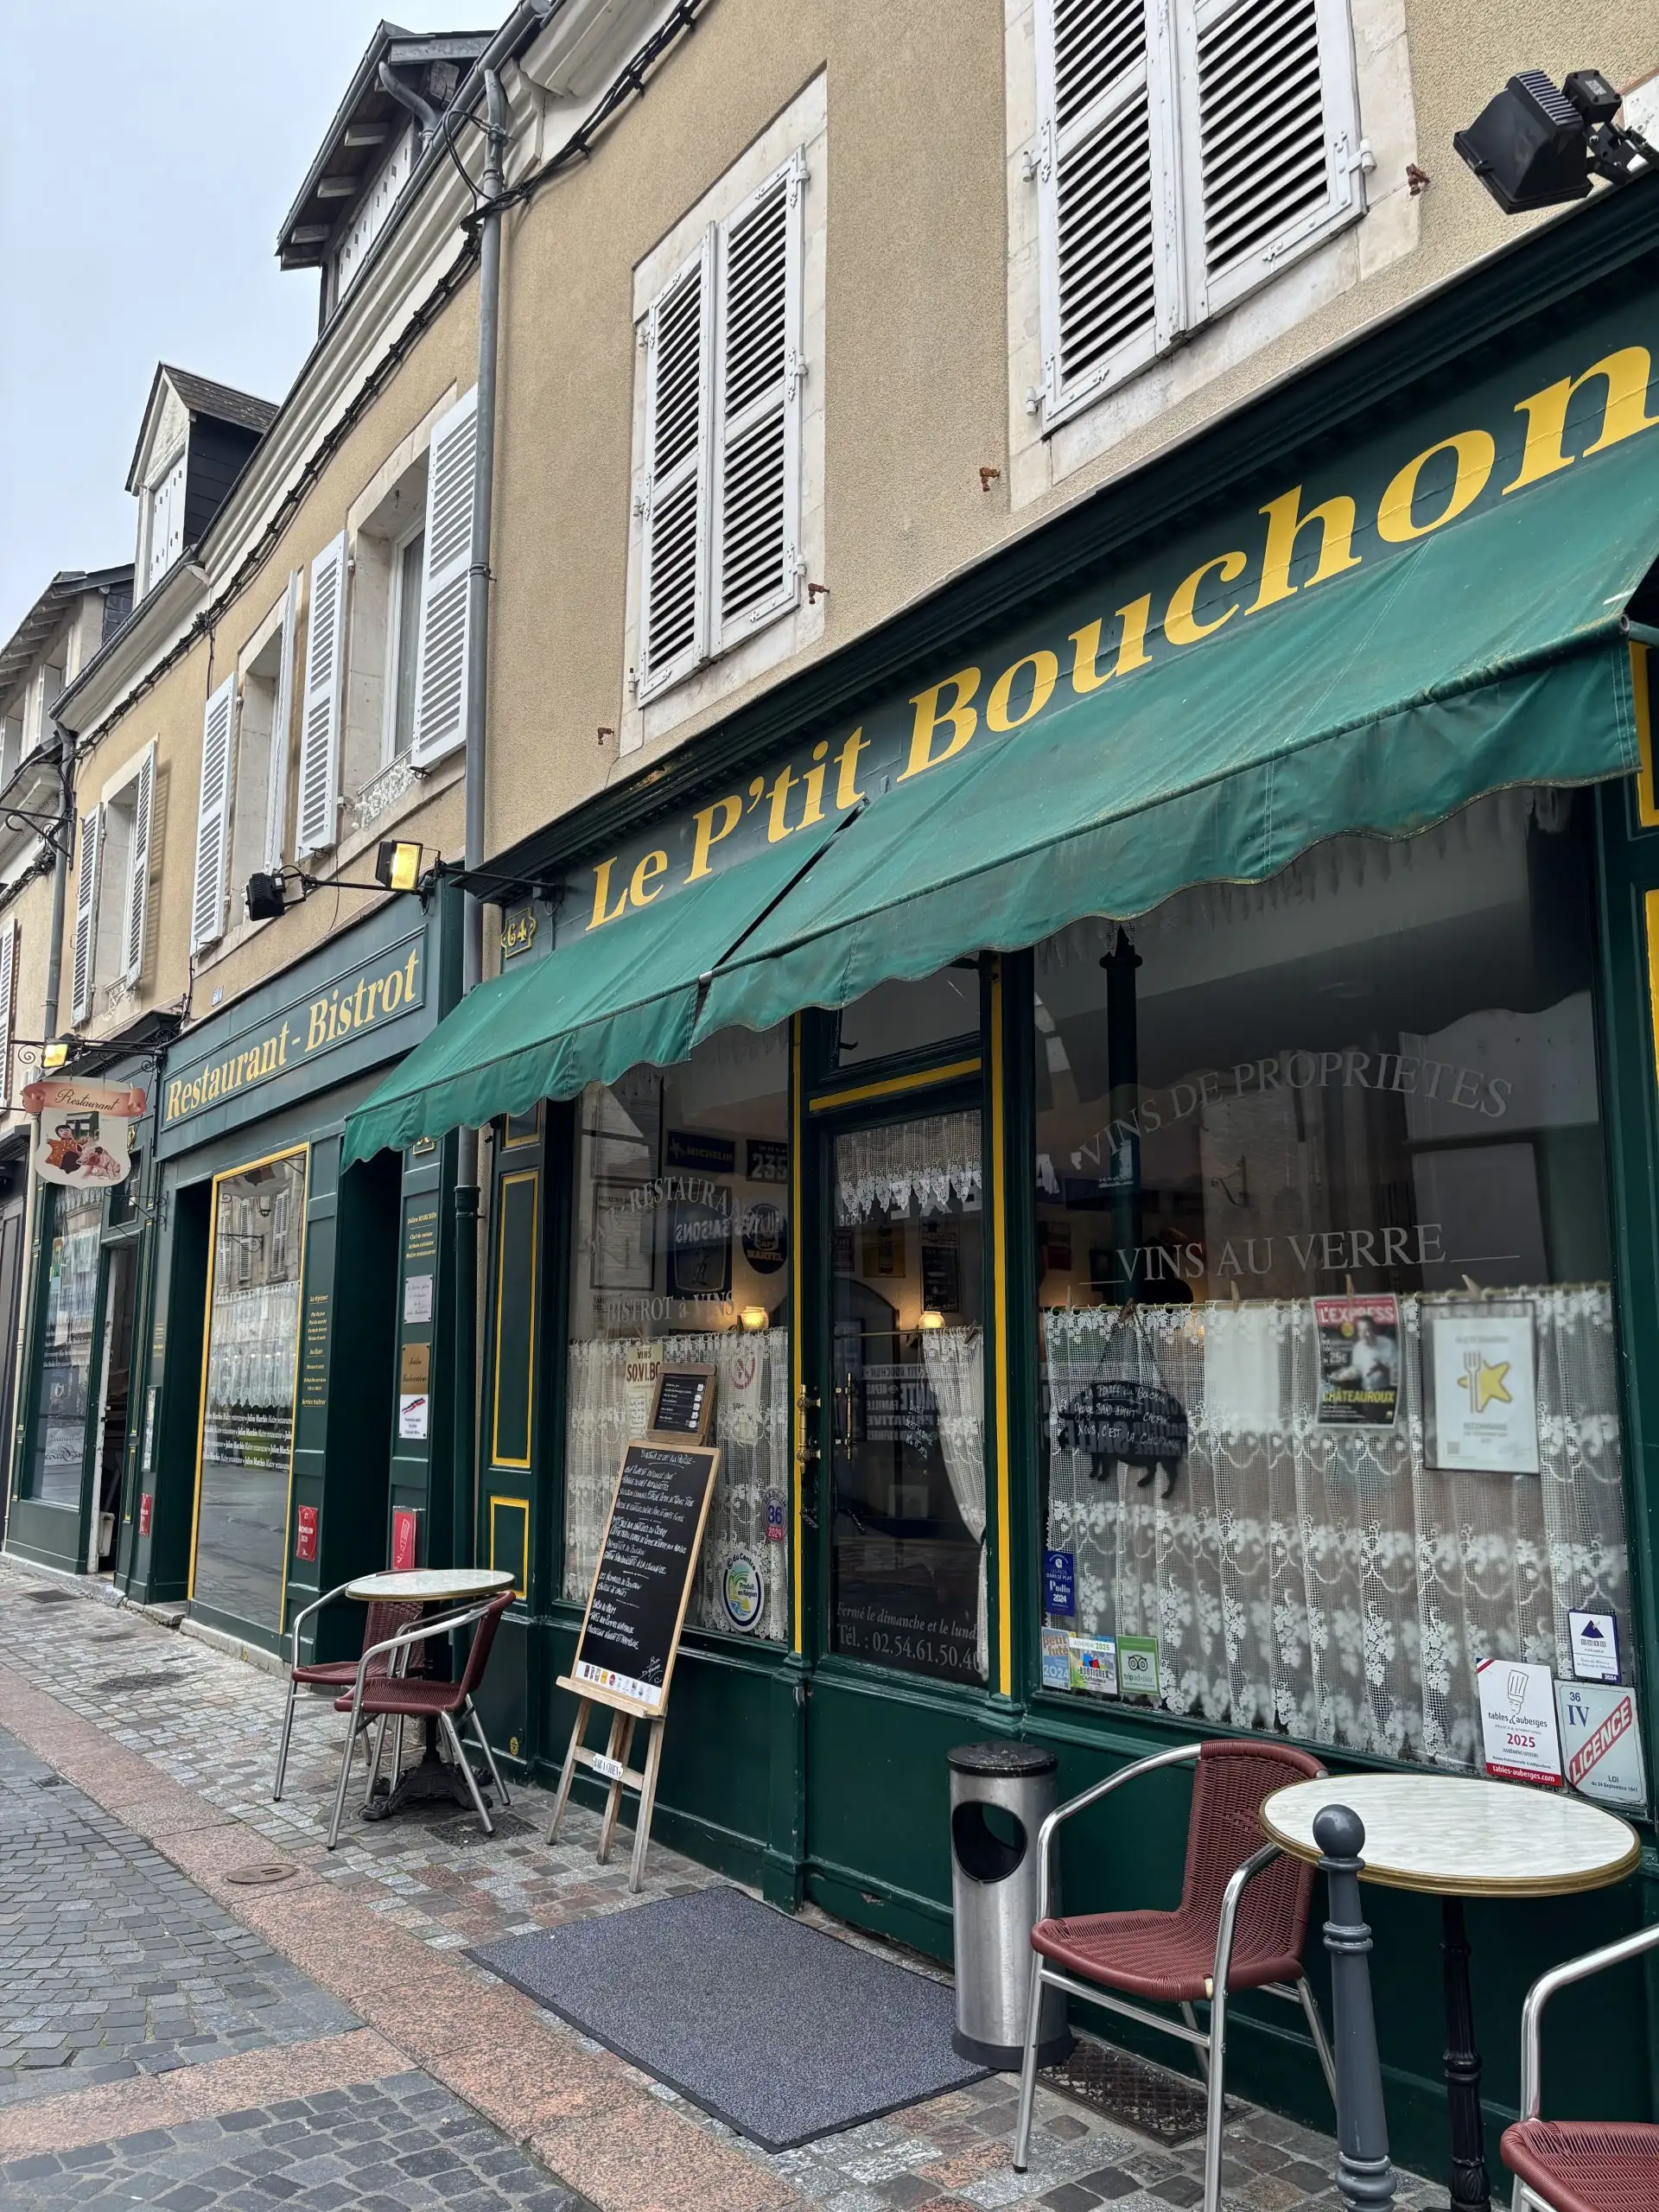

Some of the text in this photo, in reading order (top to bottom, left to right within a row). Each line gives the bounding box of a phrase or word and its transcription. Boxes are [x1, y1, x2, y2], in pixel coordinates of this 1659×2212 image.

[585, 849, 668, 931] Le
[896, 346, 1659, 783] Bouchon
[507, 918, 526, 947] 64
[165, 1020, 290, 1122] Restaurant
[304, 948, 419, 1052] Bistrot
[54, 1089, 120, 1111] Restaurant
[1079, 1052, 1514, 1167] VINS DE PROPRIETES
[686, 1147, 733, 1163] MICHELIN
[1116, 1224, 1446, 1282] VINS AU VERRE
[608, 1297, 673, 1323] BISTROT
[692, 1290, 735, 1318] VINS
[1316, 1306, 1395, 1323] L'EXPRESS
[637, 1348, 652, 1359] VINS
[767, 1504, 783, 1524] 36
[740, 1554, 756, 1571] Centre
[745, 1588, 757, 1598] Région
[1049, 1580, 1071, 1593] Pudlo
[1053, 1593, 1067, 1603] 2024
[836, 1601, 979, 1640] Fermé le dimanche et le lund
[837, 1624, 860, 1648] Tél.
[1042, 1634, 1069, 1646] petit
[1096, 1643, 1110, 1651] 2025
[1123, 1672, 1154, 1683] tripadvisor
[1569, 1692, 1581, 1701] 36
[1488, 1712, 1509, 1722] tables
[1516, 1717, 1548, 1727] auberges
[1567, 1705, 1590, 1727] IV
[1507, 1732, 1535, 1748] 2025
[1572, 1700, 1630, 1783] LICENCE
[1492, 1765, 1555, 1782] tables-auberges.com
